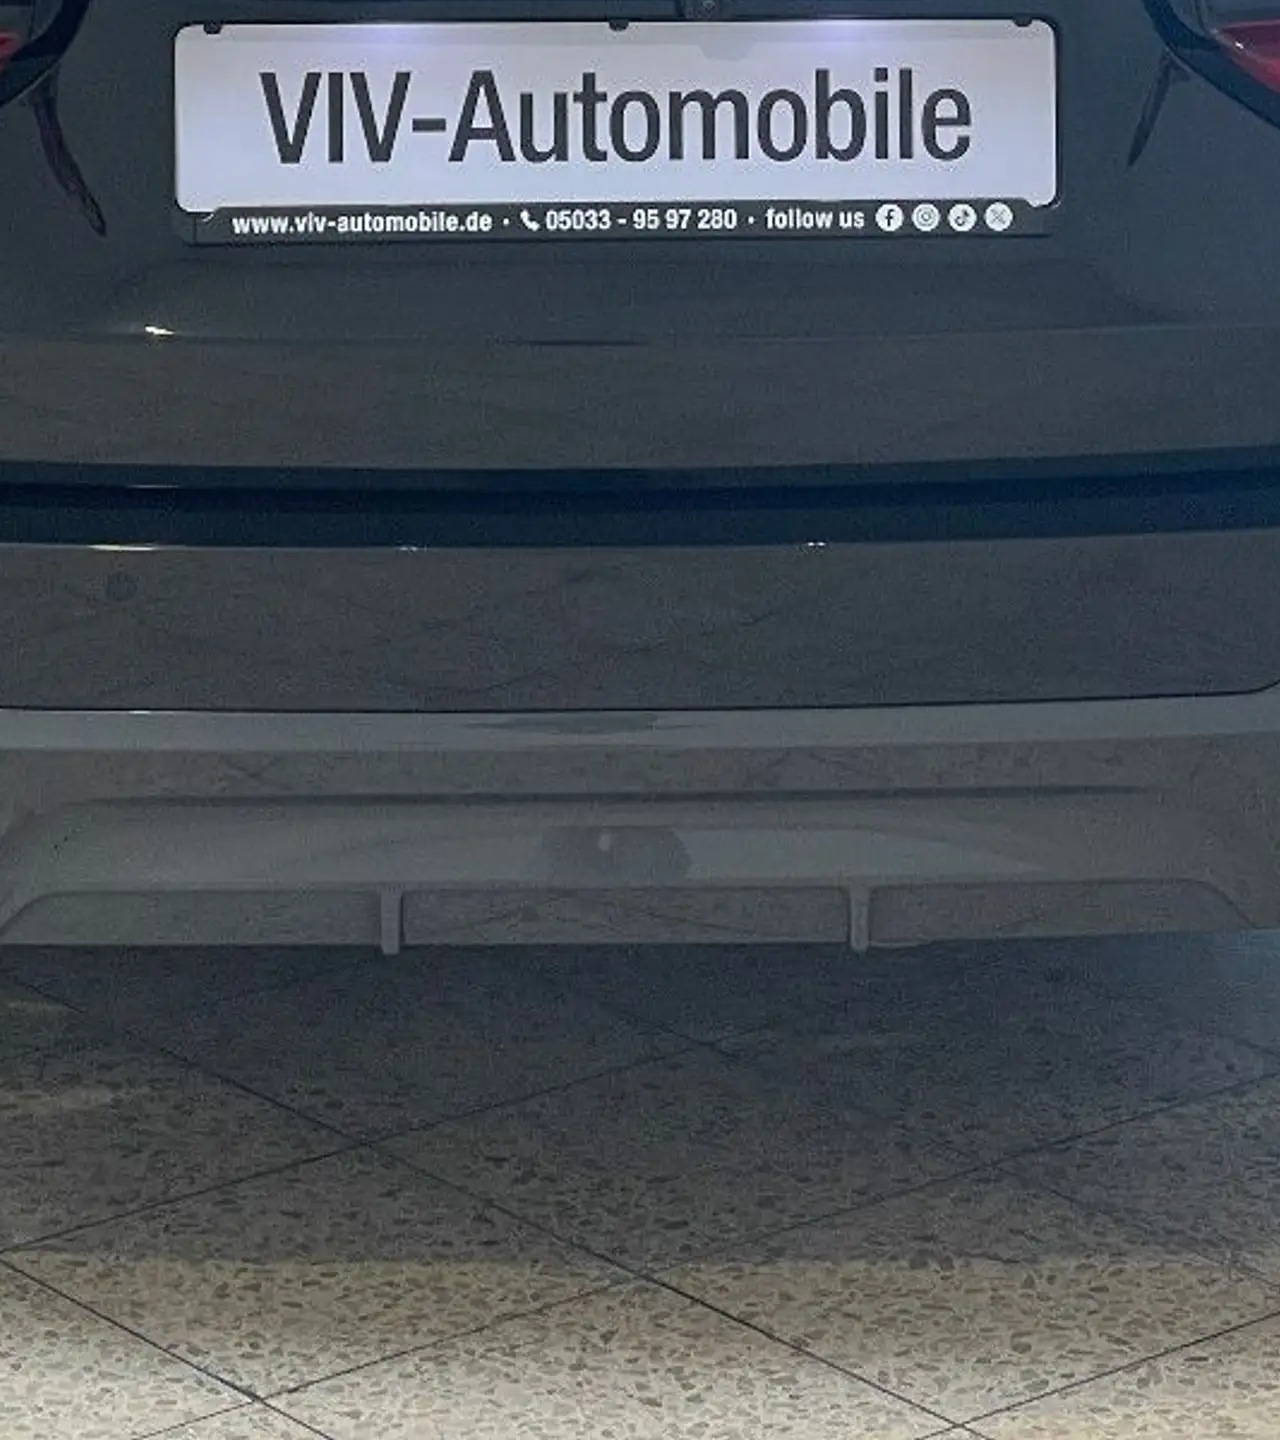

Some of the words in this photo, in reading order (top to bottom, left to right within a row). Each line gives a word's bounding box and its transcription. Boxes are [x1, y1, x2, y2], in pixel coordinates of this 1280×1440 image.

[259, 67, 972, 164] VIV-Automobile
[231, 210, 493, 234] www.viv-automobile.de
[545, 209, 612, 231] 05033
[632, 208, 660, 230] 95
[664, 208, 691, 230] 97
[696, 208, 738, 230] 280
[765, 207, 833, 230] follow
[838, 210, 865, 229] us
